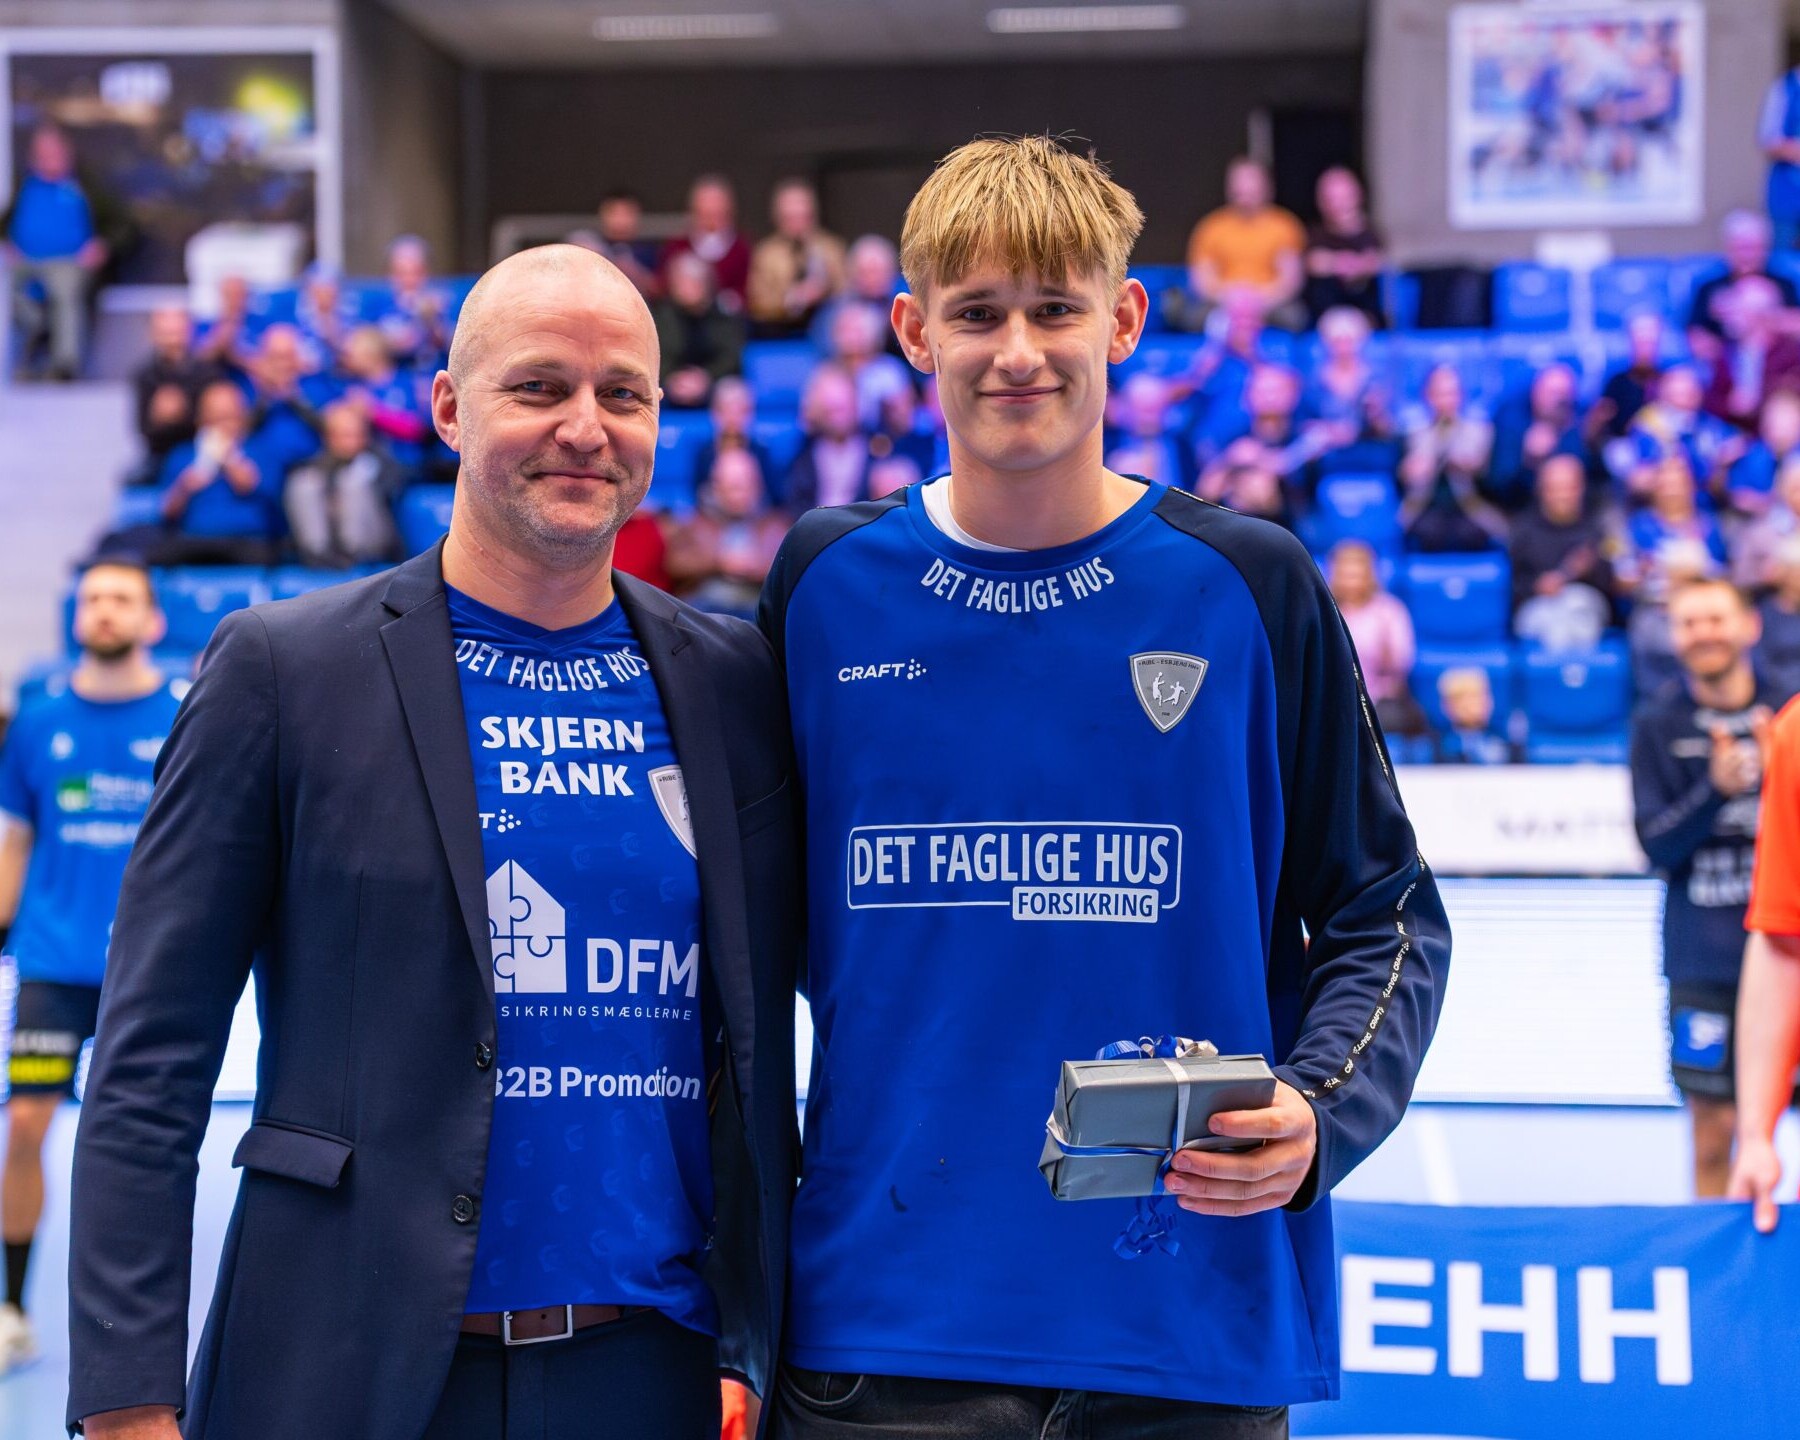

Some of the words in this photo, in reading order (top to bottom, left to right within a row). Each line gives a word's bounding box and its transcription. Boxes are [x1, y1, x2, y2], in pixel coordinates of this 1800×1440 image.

[920, 557, 967, 601] DET
[965, 575, 1064, 614] FAGLIGE
[1065, 556, 1115, 600] HUS
[454, 639, 504, 677] DET
[507, 654, 609, 692] FAGLIGE
[604, 646, 650, 683] HUS
[838, 663, 905, 682] CRAFT
[480, 716, 645, 756] SKJERN
[500, 761, 635, 797] BANK
[853, 837, 916, 885] DET
[929, 833, 1081, 884] FAGLIGE
[1095, 834, 1170, 885] HUS
[1018, 891, 1153, 917] FORSIKRING
[586, 937, 700, 998] DFM
[560, 1066, 700, 1099] Promotion
